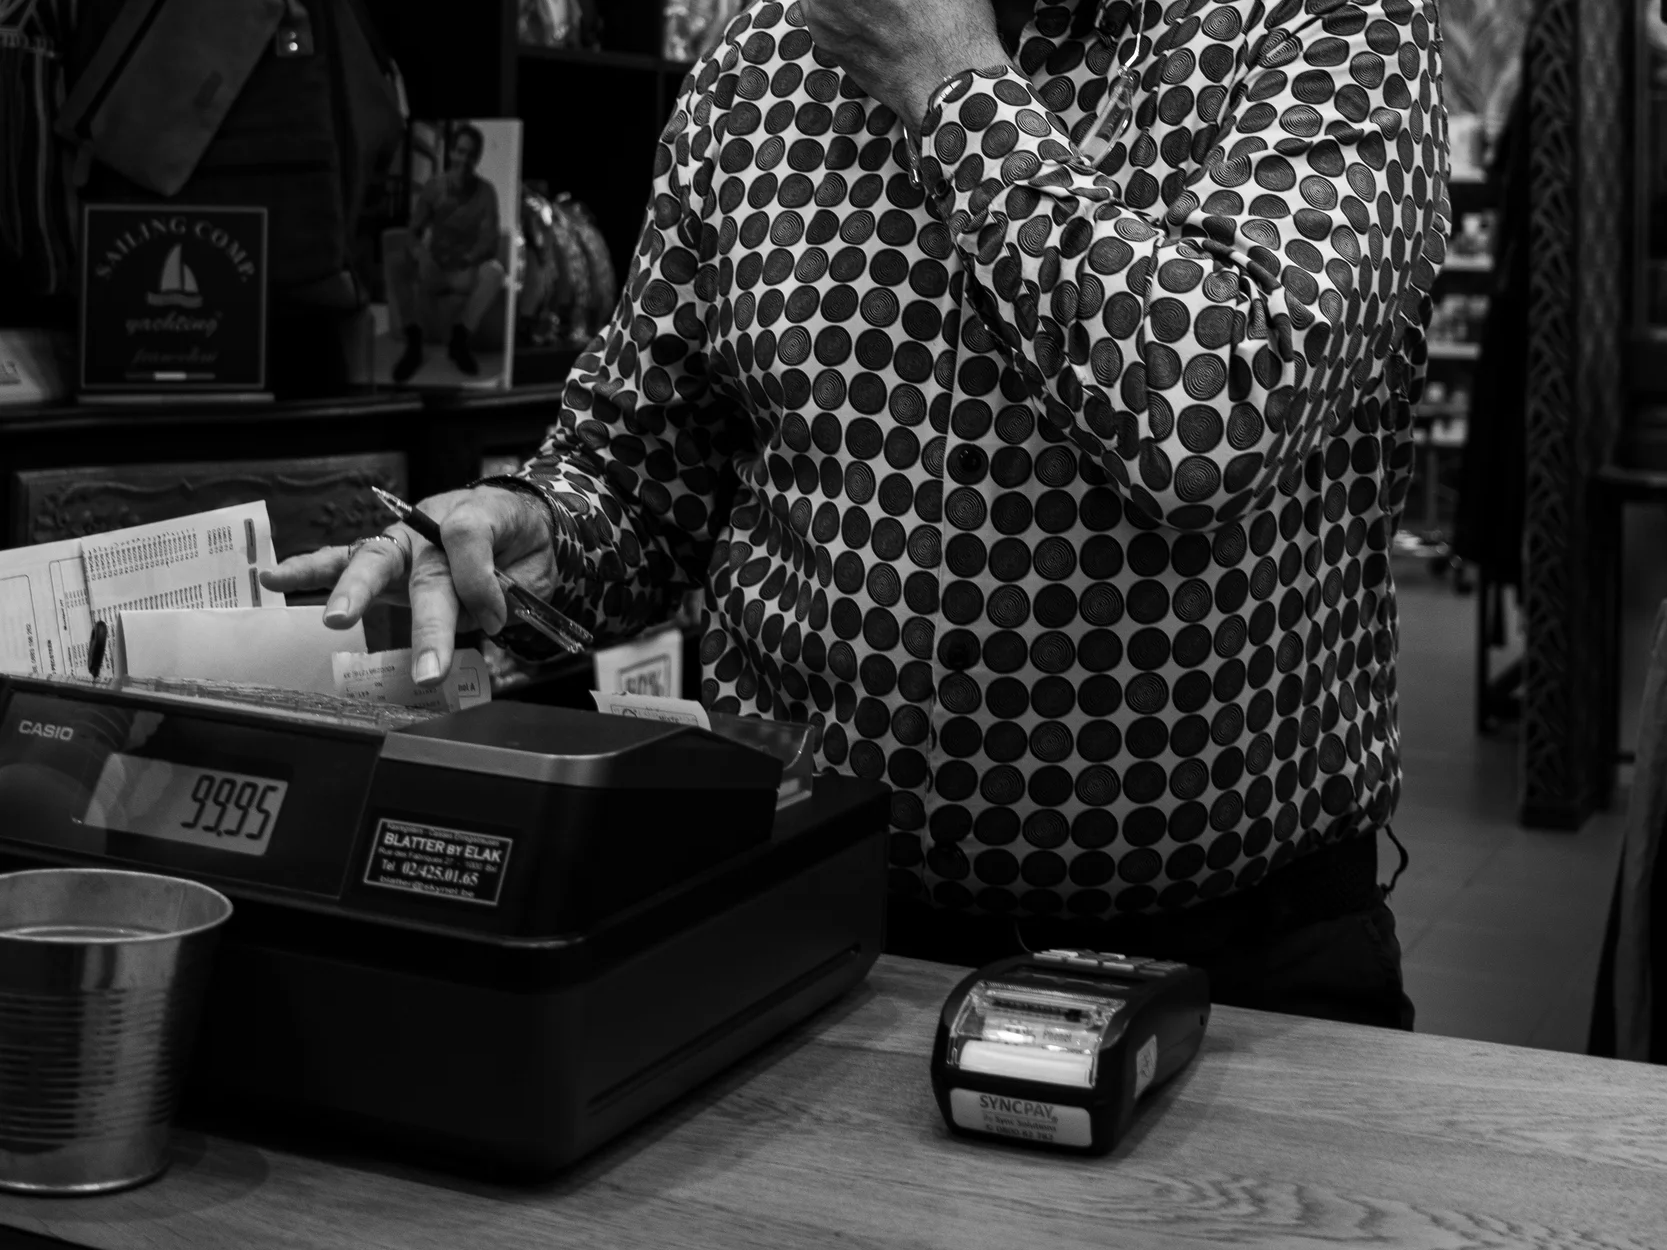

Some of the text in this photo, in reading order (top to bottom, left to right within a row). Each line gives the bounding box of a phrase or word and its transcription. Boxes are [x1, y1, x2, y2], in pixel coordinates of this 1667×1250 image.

[94, 216, 256, 283] SAILING COMP.
[18, 719, 74, 741] CASIO
[383, 832, 502, 863] BLATTER BY ELAK
